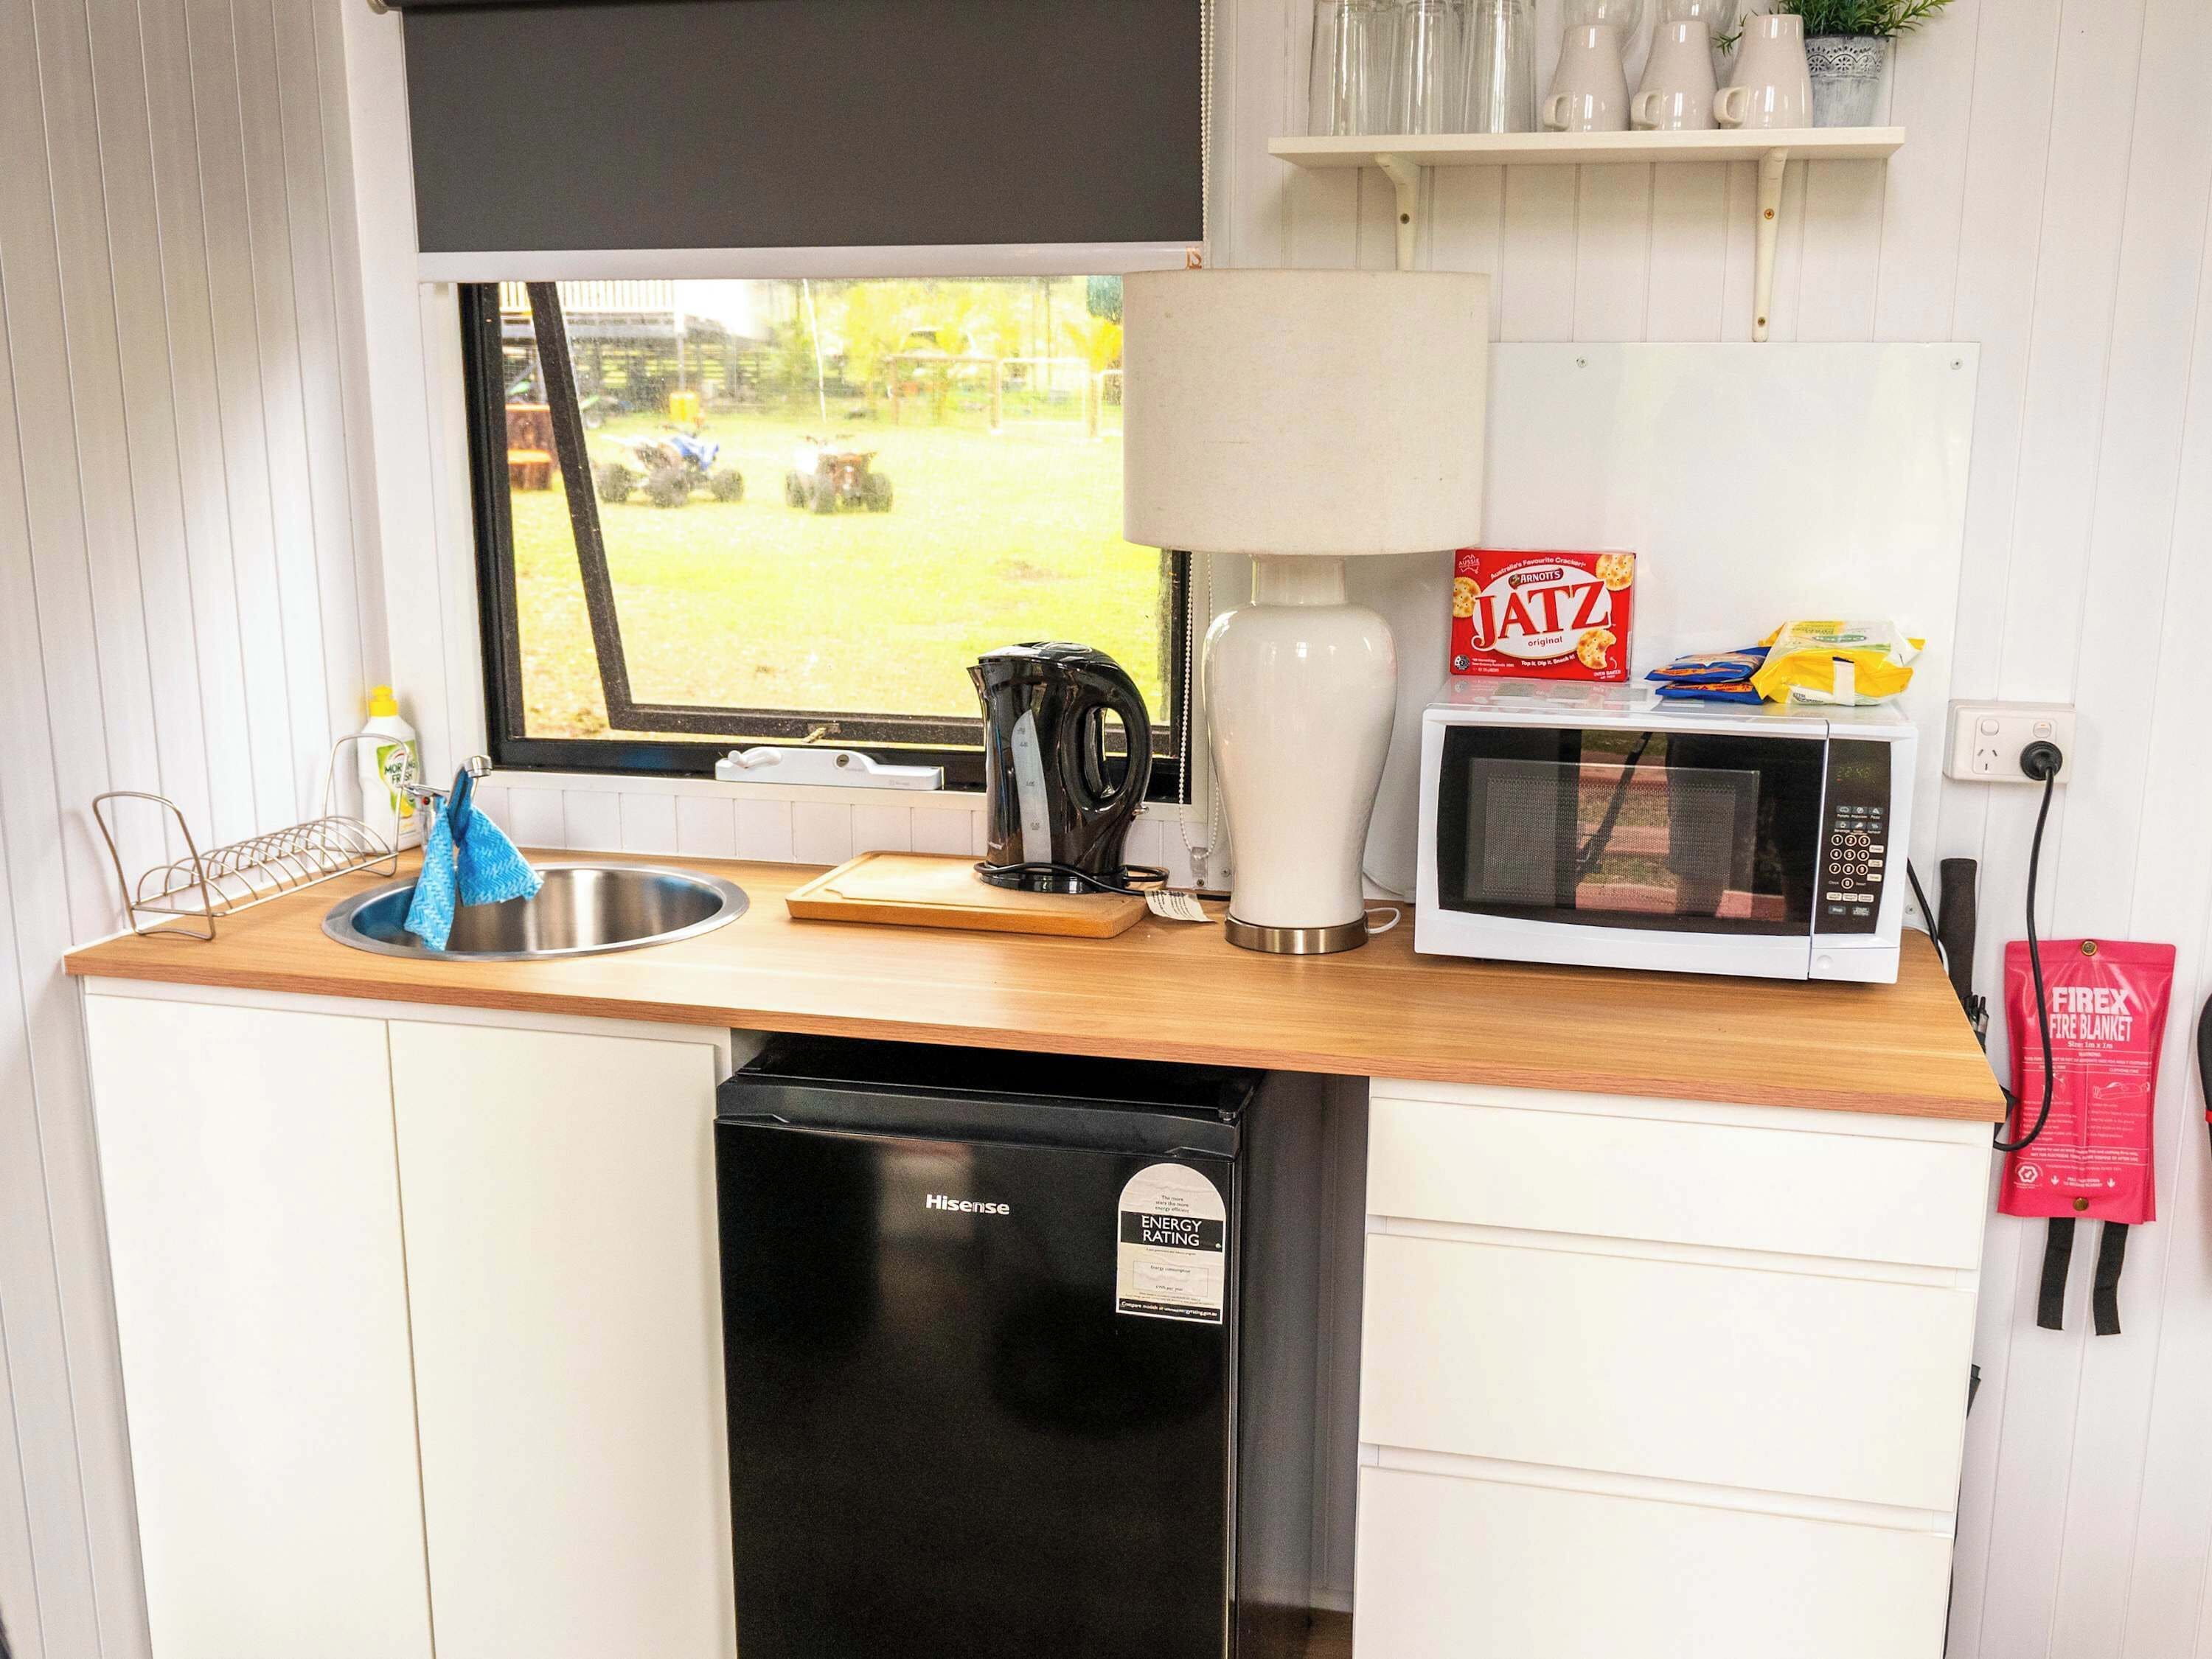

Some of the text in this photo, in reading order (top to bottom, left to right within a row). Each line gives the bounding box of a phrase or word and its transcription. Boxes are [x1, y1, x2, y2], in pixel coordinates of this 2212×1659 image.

[1523, 557, 1554, 566] Favourite
[1472, 580, 1610, 649] JATZ
[1528, 636, 1563, 647] original
[2052, 987, 2131, 1015] FIREX
[2049, 1014, 2133, 1042] FIRE BLANKET
[926, 1194, 1010, 1215] Hisense
[1141, 1215, 1202, 1232] ENERGY
[1143, 1229, 1200, 1246] RATING
[1121, 1301, 1142, 1309] Compare
